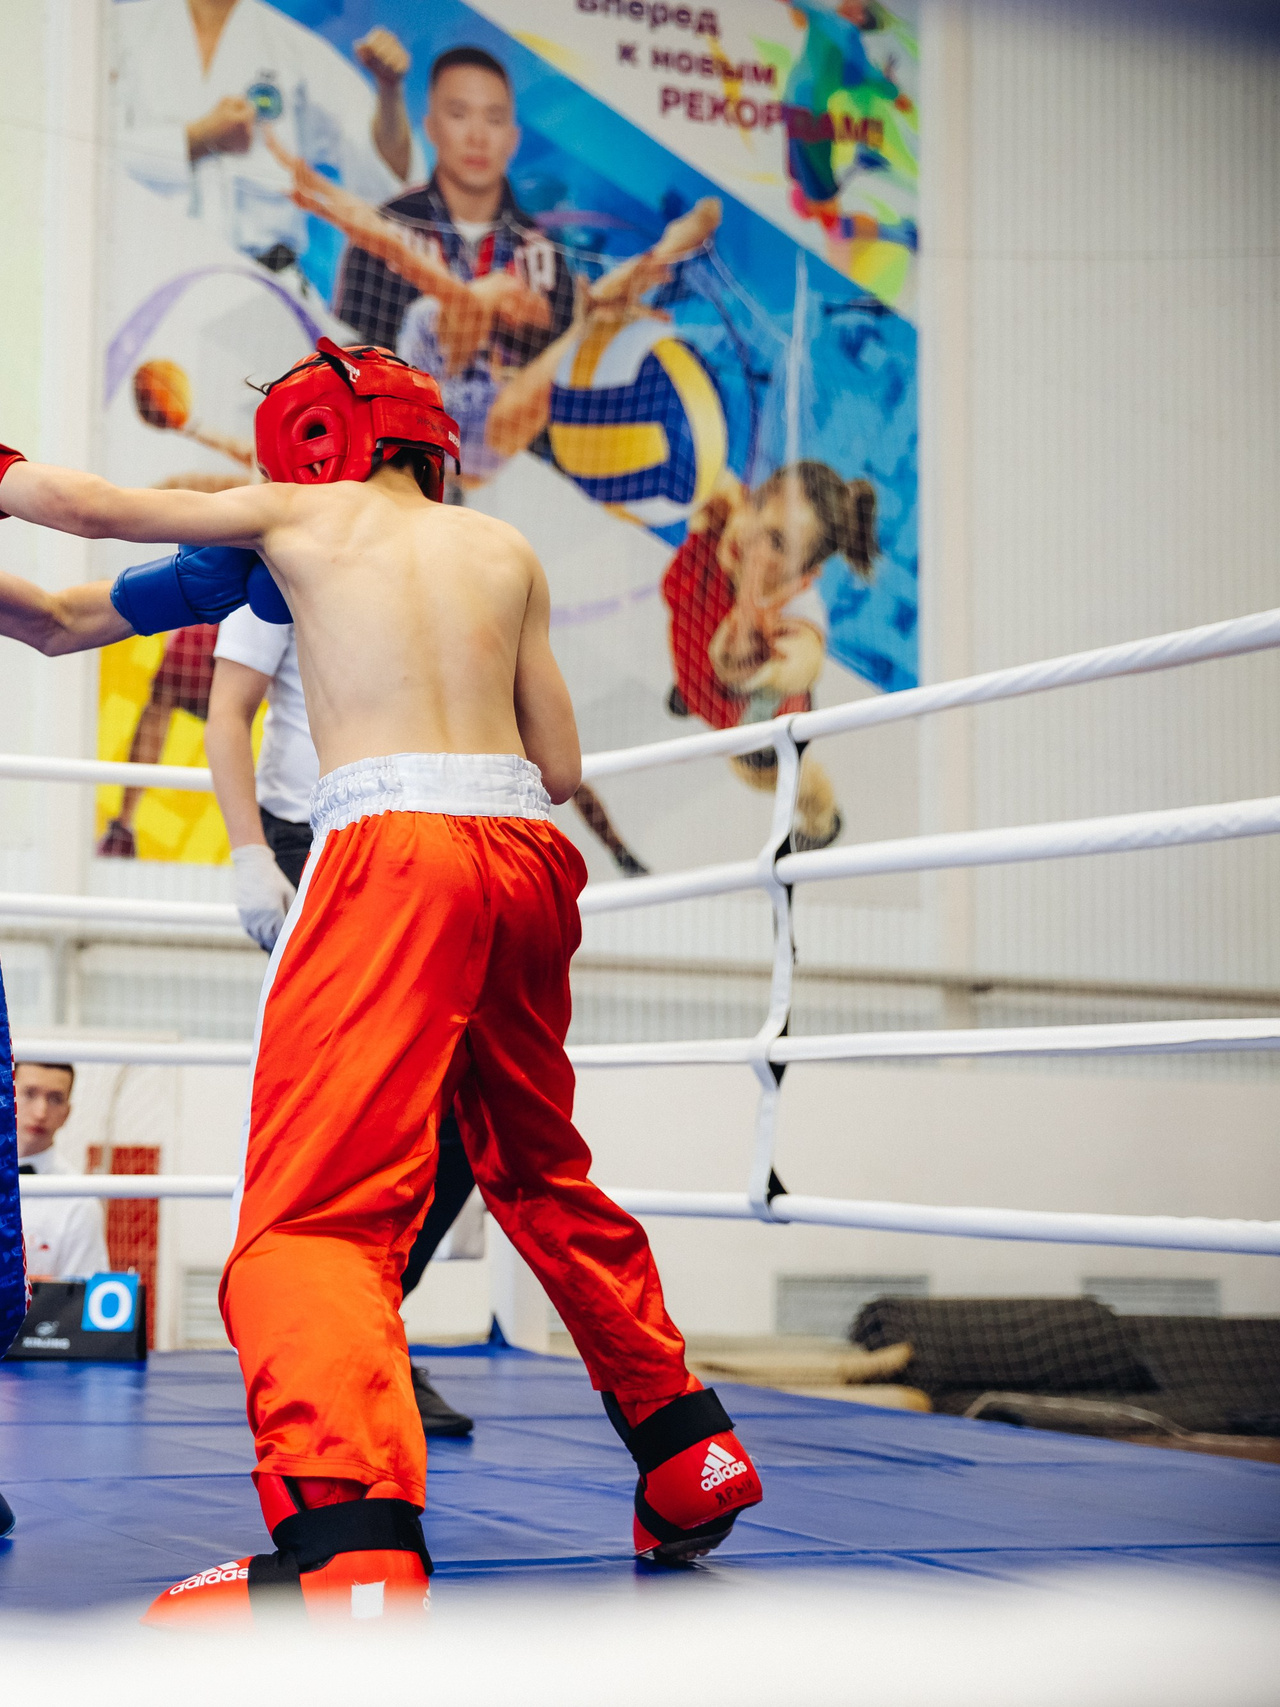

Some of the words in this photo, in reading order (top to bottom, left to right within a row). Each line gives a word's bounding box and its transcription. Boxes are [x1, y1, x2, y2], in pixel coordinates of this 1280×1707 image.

[651, 48, 778, 87] новым
[700, 1460, 748, 1492] adidas
[169, 1565, 249, 1595] adidas
